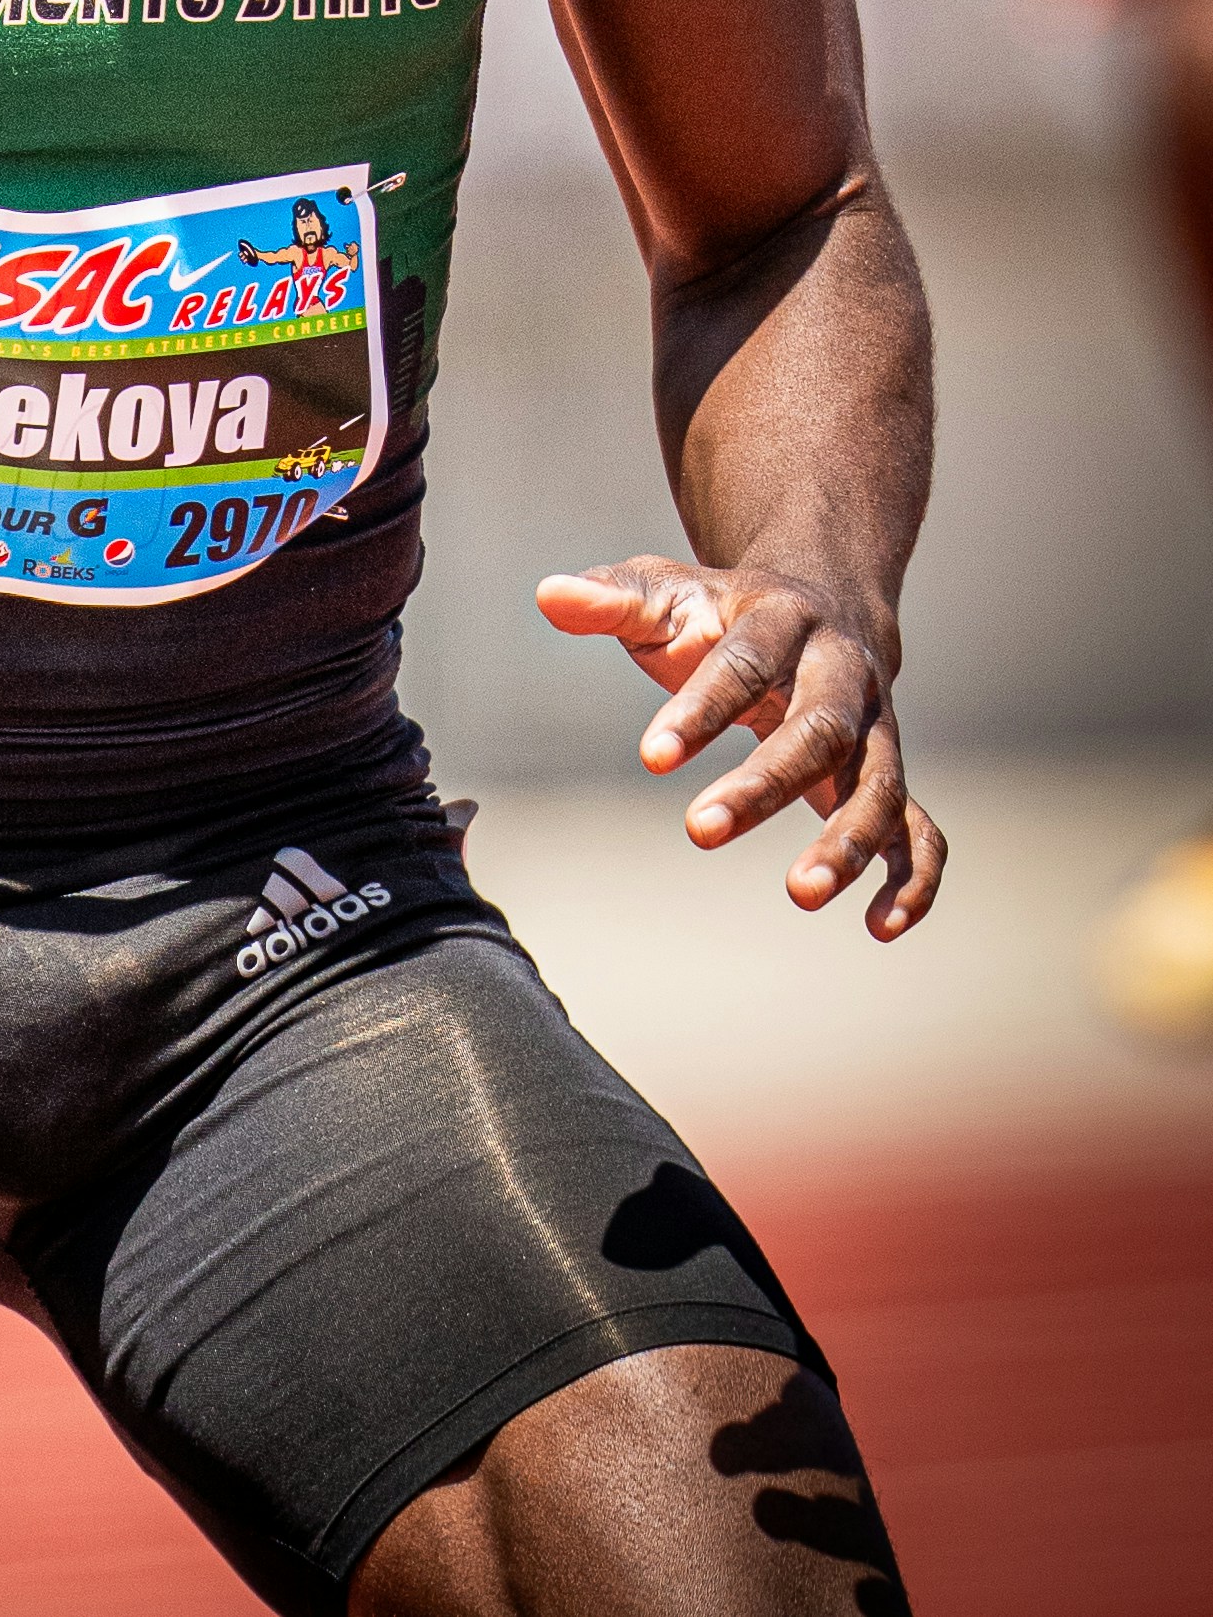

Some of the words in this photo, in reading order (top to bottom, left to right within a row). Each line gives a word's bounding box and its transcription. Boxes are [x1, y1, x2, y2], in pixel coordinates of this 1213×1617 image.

[169, 266, 351, 331] RELAYS
[71, 344, 128, 358] BEST
[145, 330, 257, 354] ATHLETES
[273, 313, 363, 340] COMPETE
[164, 488, 319, 568] 2970
[237, 882, 391, 978] adidas
